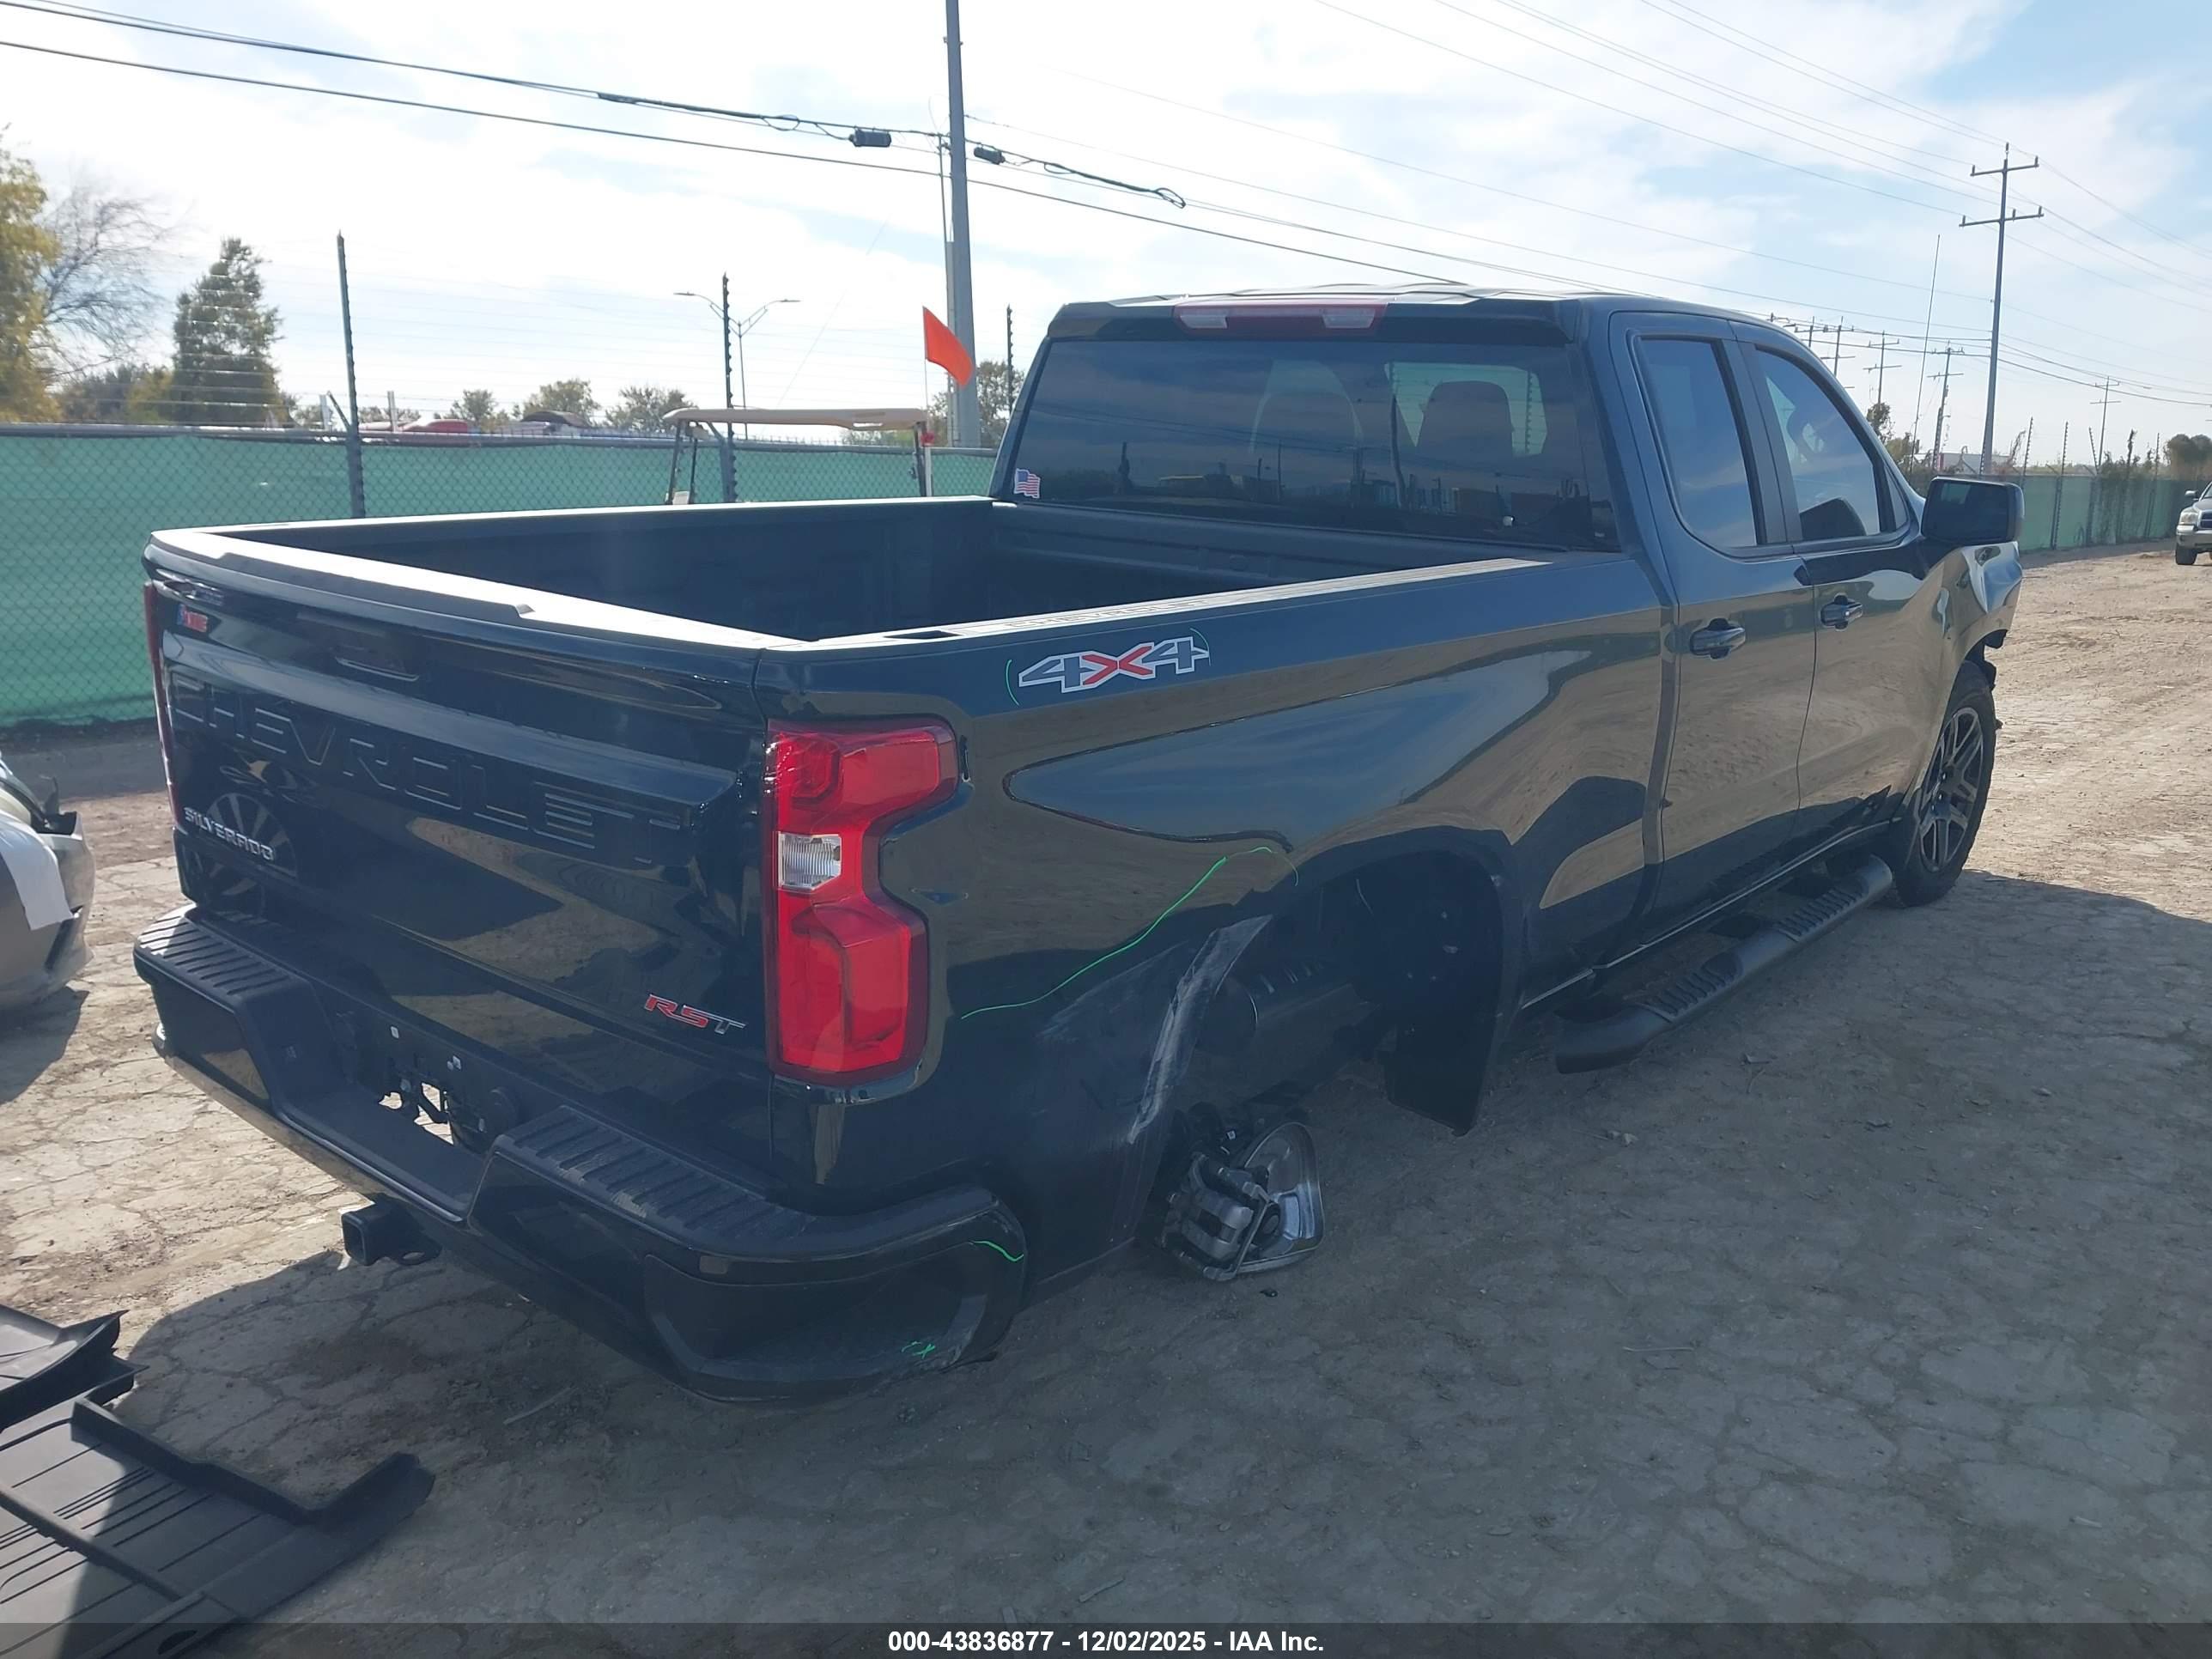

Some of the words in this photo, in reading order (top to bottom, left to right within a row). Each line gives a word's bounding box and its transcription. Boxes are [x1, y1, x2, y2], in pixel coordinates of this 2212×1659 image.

[173, 673, 682, 864] CHEVROLET
[184, 807, 274, 860] SILVERADO
[644, 994, 747, 1035] RST
